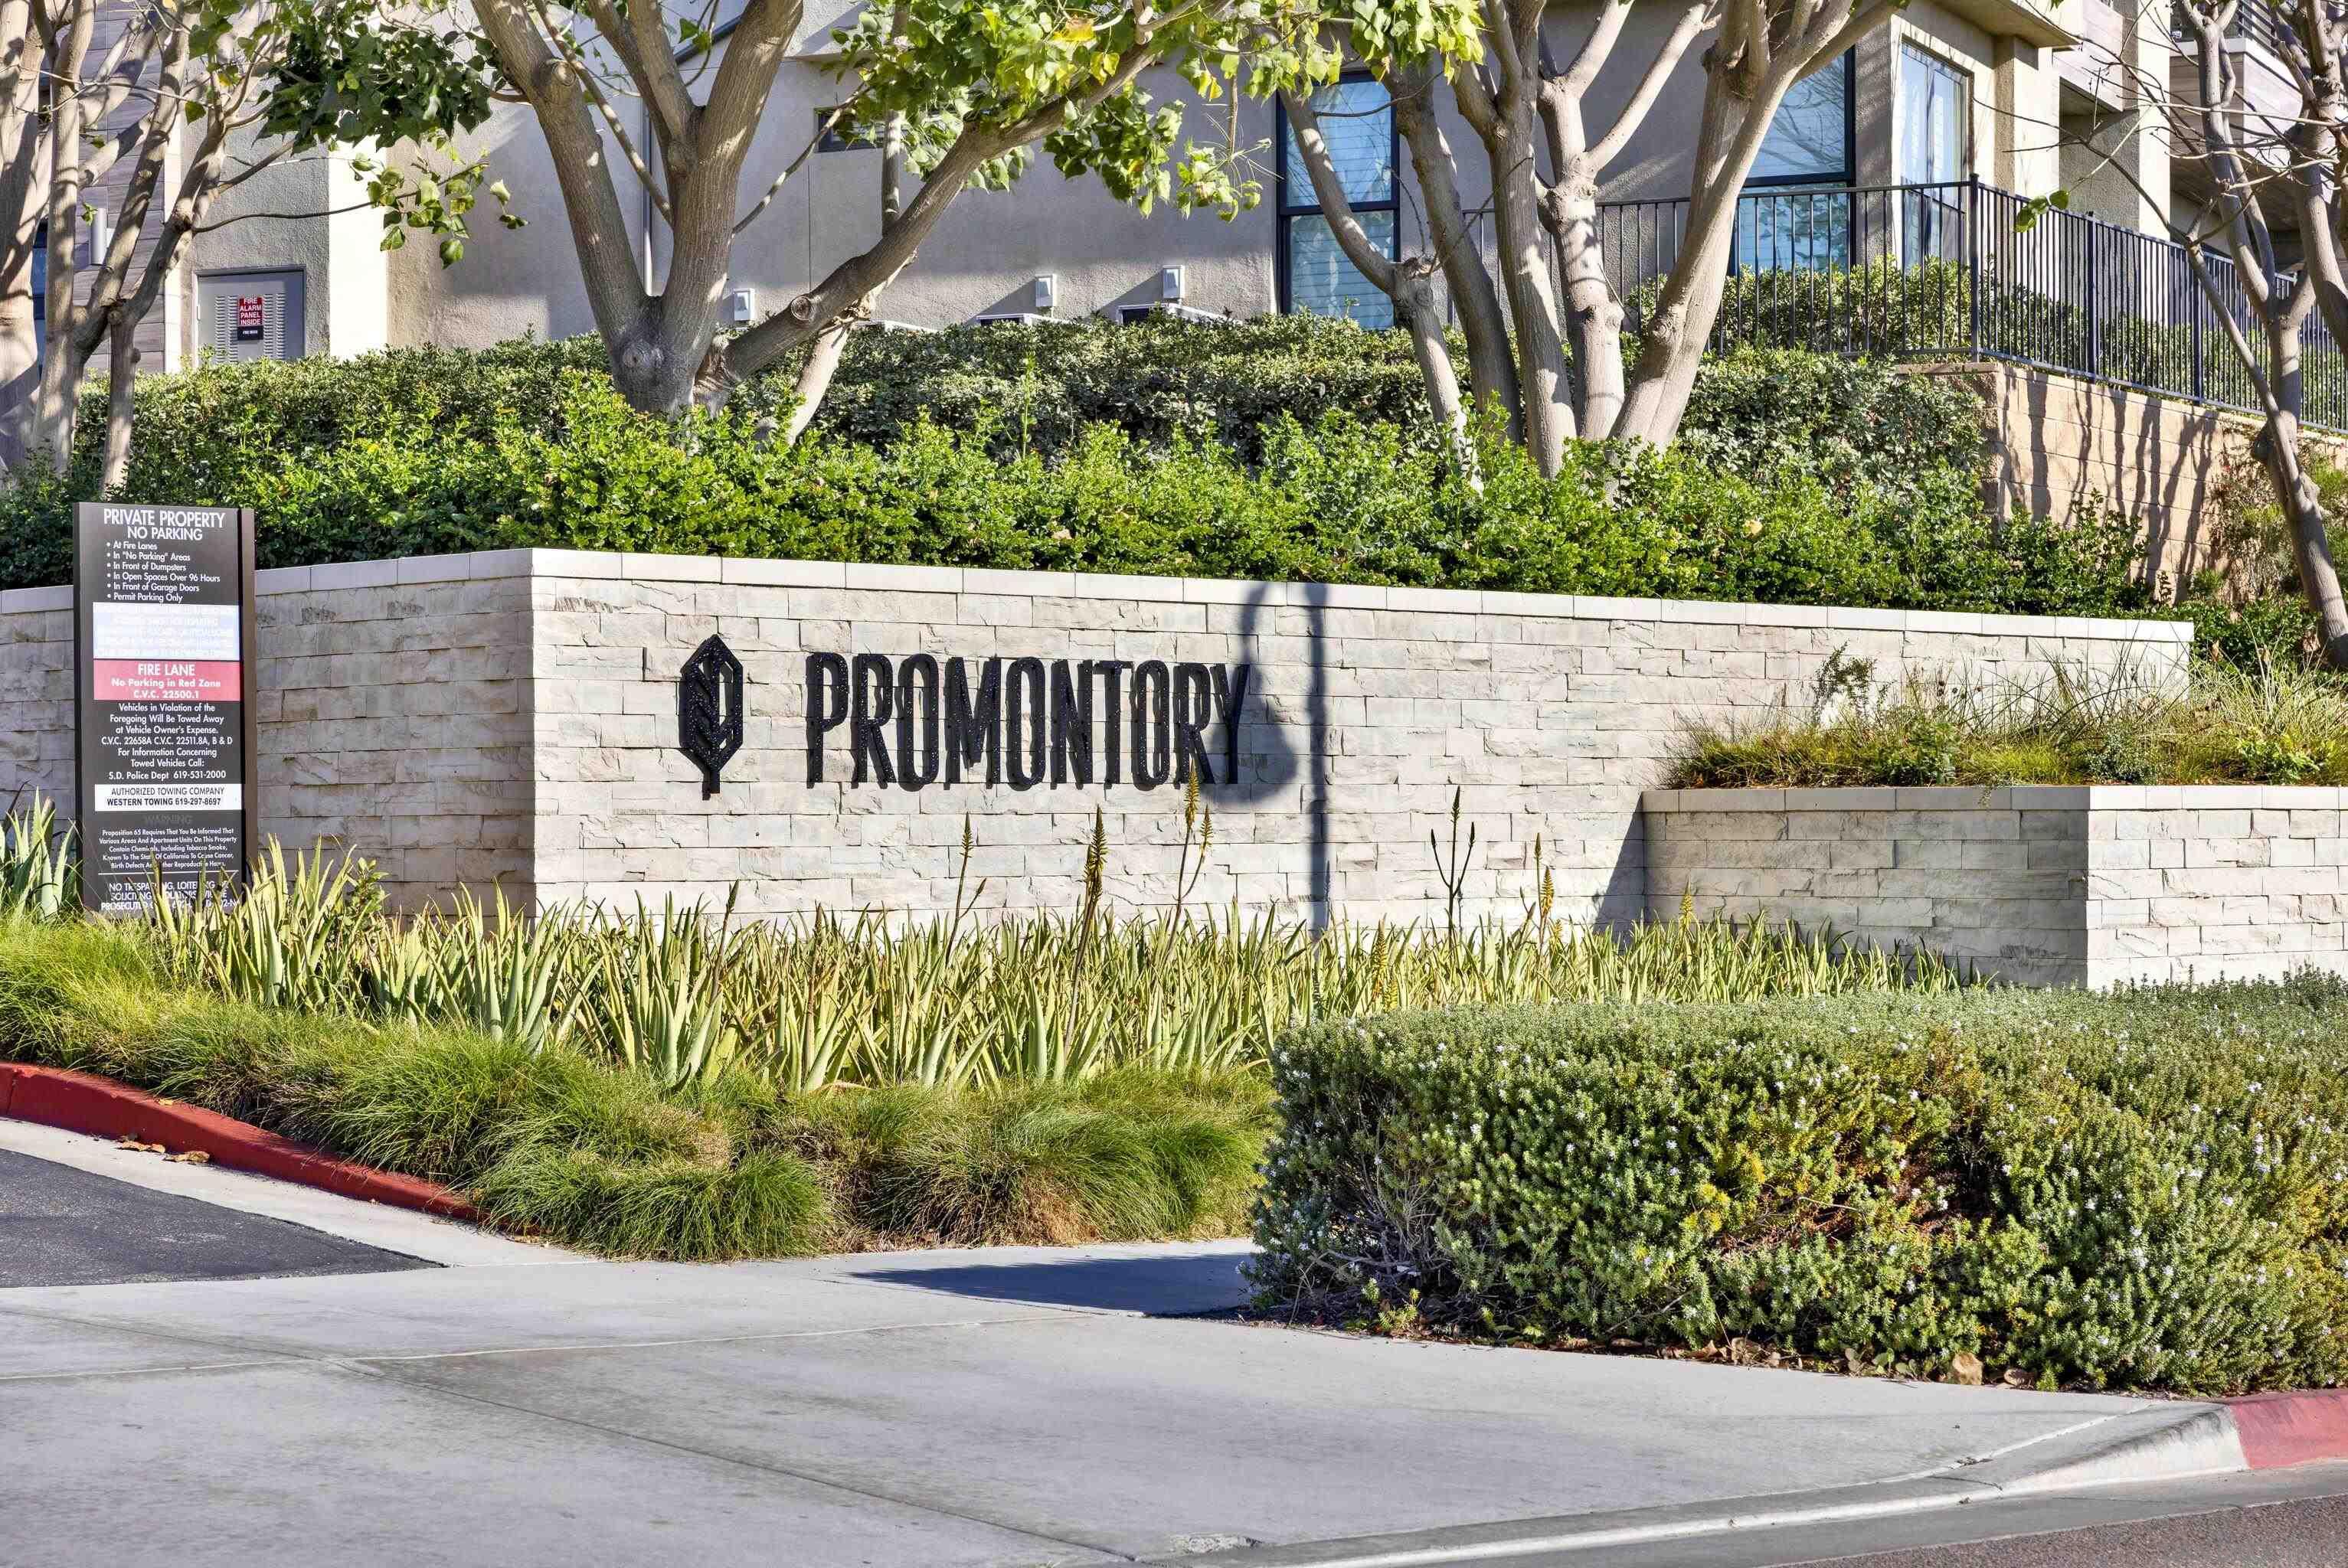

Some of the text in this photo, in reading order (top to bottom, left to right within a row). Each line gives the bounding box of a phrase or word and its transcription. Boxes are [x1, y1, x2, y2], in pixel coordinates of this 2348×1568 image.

[103, 508, 225, 528] PRIVATE PROPERTY
[127, 526, 202, 541] NO PARKING
[151, 564, 186, 572] Dumpsters
[123, 573, 142, 582] Open
[145, 574, 168, 583] Spaces
[151, 583, 177, 593] Garage
[138, 593, 163, 603] Parking
[166, 595, 182, 603] Only
[138, 664, 195, 676] FIRE LANE
[129, 679, 164, 688] Parking
[119, 704, 215, 712] Vehicles in Violation of the
[110, 715, 146, 724] Foregoing
[149, 714, 163, 723] Will
[178, 714, 201, 723] Towed
[203, 715, 224, 725] Away
[806, 652, 1250, 789] PROMONTORY
[124, 737, 152, 745] 22658A
[154, 737, 174, 745] C.V.C.
[177, 748, 217, 757] Concerning
[109, 772, 124, 780] S.D.
[152, 772, 168, 781] Dept
[157, 787, 187, 795] TOWING
[189, 787, 224, 795] COMPANY
[145, 798, 173, 806] TOWING
[110, 883, 123, 891] NO
